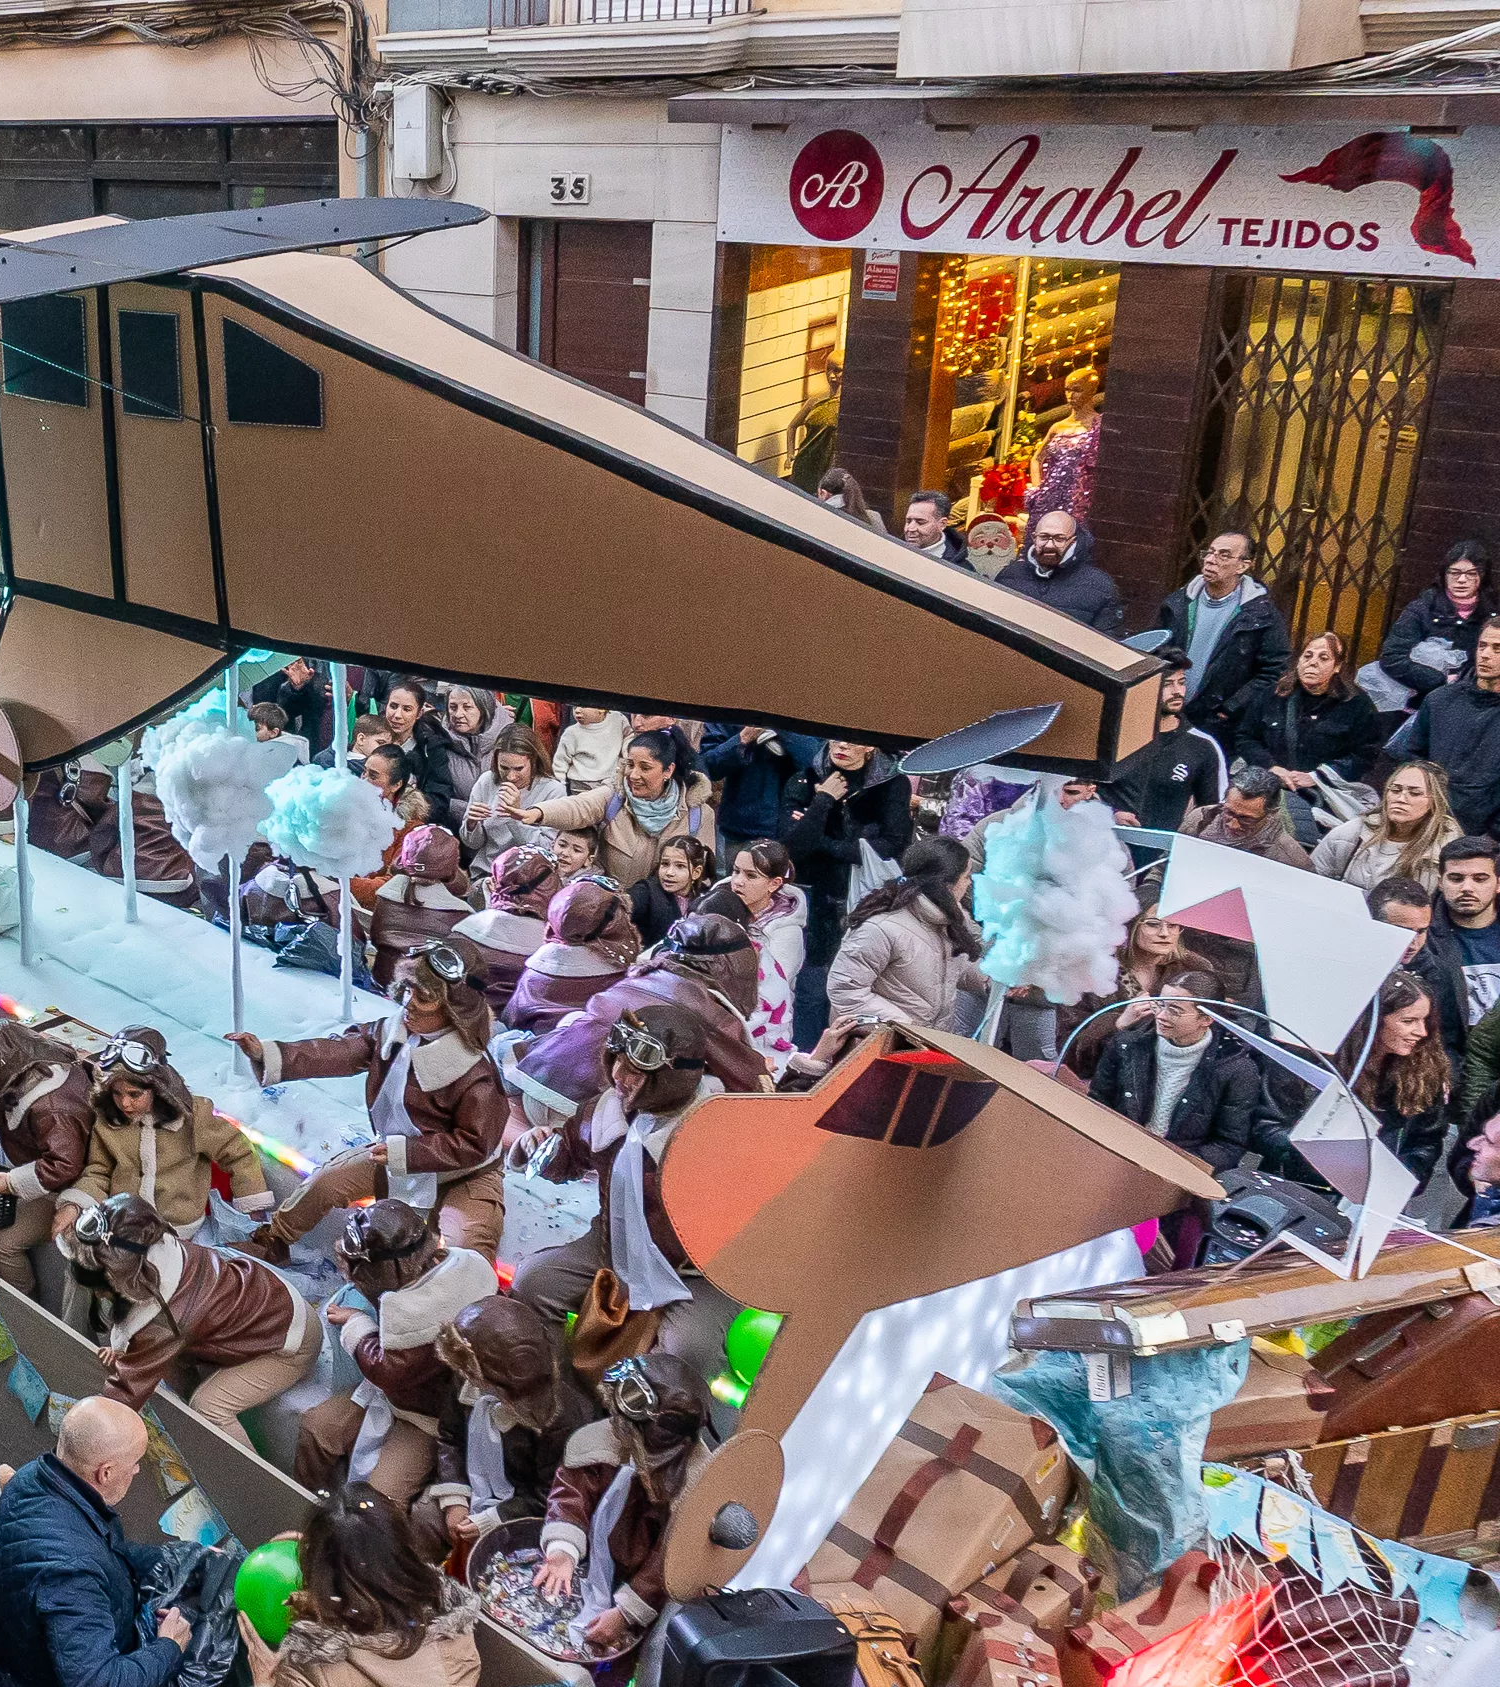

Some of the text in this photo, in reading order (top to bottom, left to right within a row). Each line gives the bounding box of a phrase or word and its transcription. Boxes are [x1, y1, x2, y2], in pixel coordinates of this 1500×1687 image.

[550, 177, 586, 201] 35
[800, 160, 869, 210] AB
[900, 133, 1382, 253] Arabel TEJIDOS
